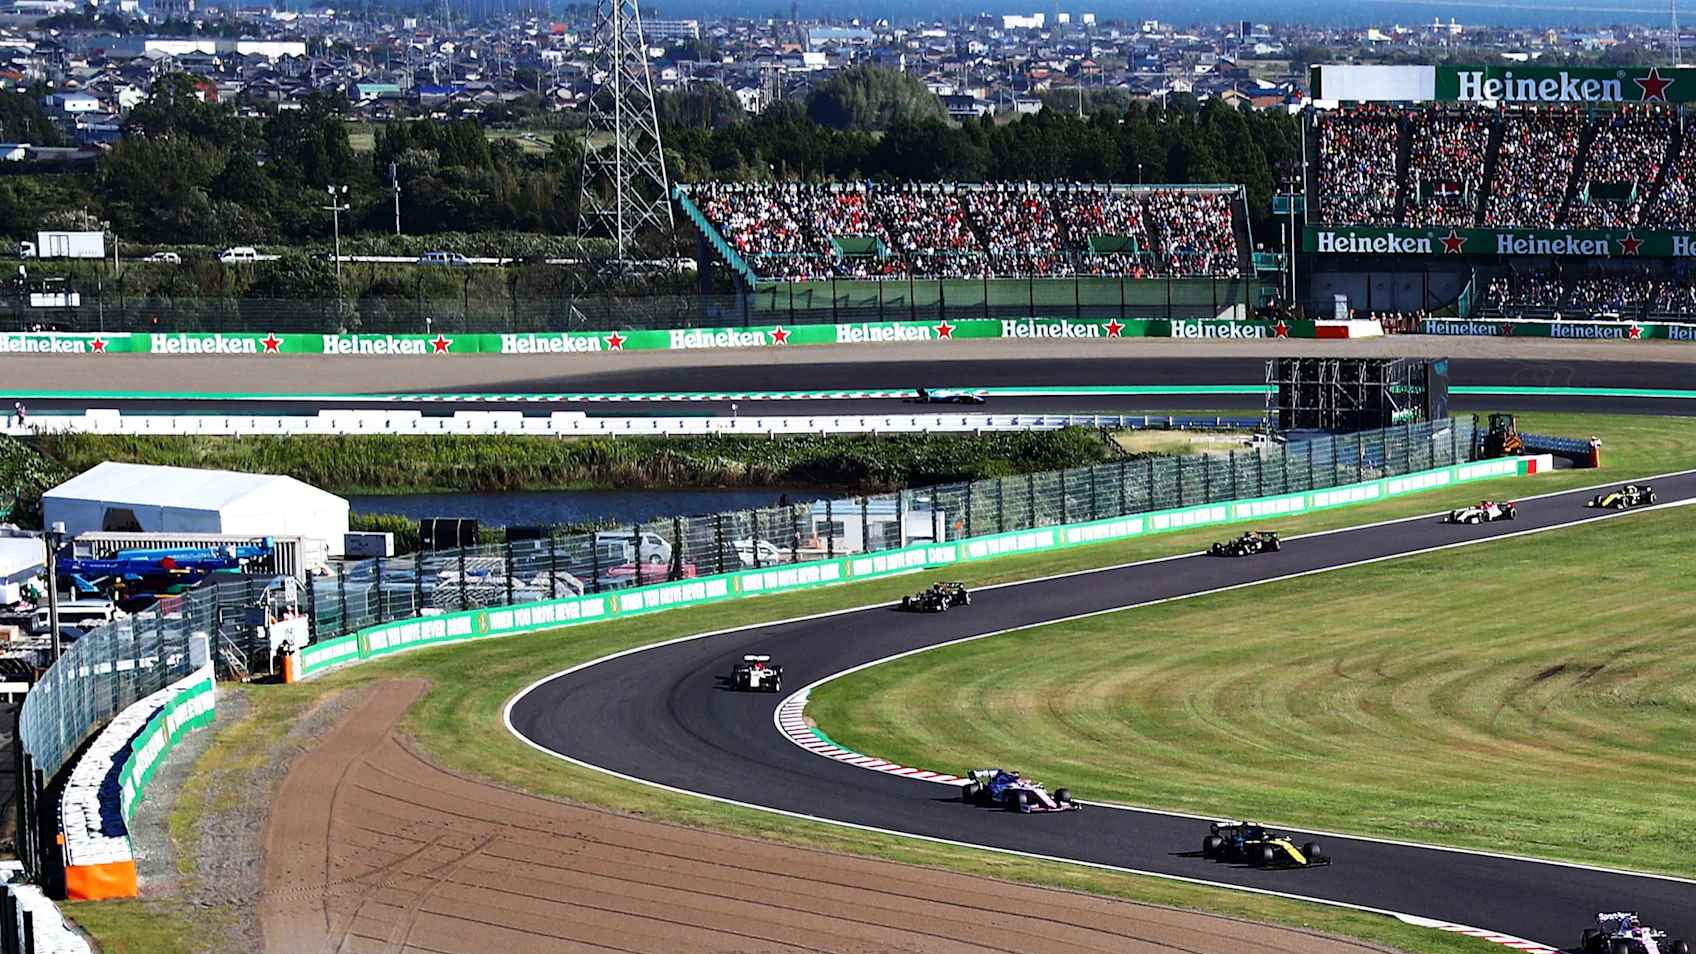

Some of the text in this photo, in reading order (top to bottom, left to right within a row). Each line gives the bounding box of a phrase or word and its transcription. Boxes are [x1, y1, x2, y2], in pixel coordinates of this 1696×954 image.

[1456, 71, 1624, 102] Heineken
[1317, 232, 1433, 254] Heineken
[1496, 233, 1610, 256] Heineken
[836, 322, 931, 343] Heineken
[1001, 319, 1100, 338] Heineken
[1170, 319, 1268, 338] Heineken
[1426, 320, 1497, 336] Heineken
[1550, 323, 1623, 339] Heineken
[150, 333, 257, 353] Heineken
[323, 334, 426, 354] Heineken
[500, 333, 601, 353] Heineken
[669, 328, 766, 349] Heineken
[620, 593, 642, 611] WHEN
[644, 590, 659, 607] YOU
[660, 586, 682, 604] DRIVE
[683, 582, 704, 601] NEVER
[490, 611, 512, 629] WHEN
[514, 609, 530, 626] YOU
[531, 605, 555, 624] DRIVE
[556, 602, 579, 621] NEVER
